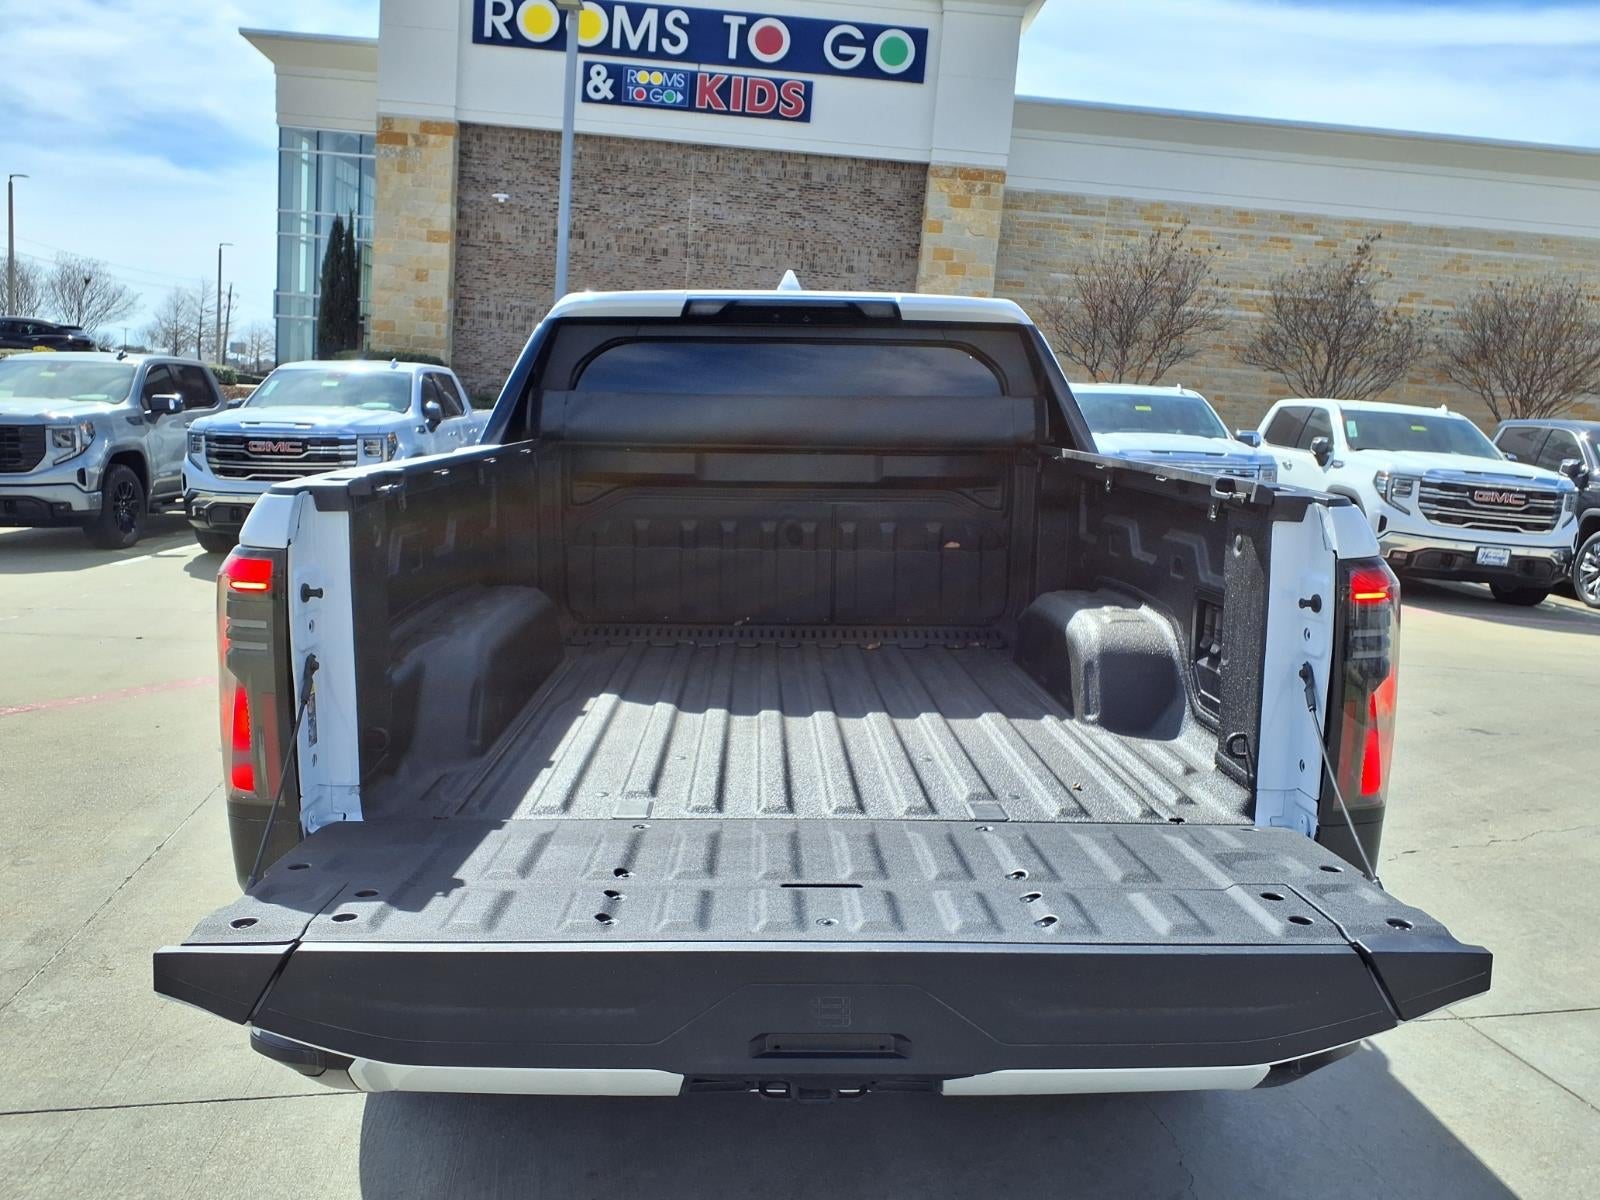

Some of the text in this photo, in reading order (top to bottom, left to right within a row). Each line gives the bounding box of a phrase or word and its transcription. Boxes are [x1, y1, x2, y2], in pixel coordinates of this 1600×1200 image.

[483, 0, 916, 74] ROOMS TO GO
[586, 64, 615, 100] &
[627, 69, 685, 88] ROOMS
[627, 86, 678, 103] TO GO
[695, 72, 806, 118] KIDS
[249, 441, 303, 452] GMC
[1474, 490, 1526, 505] GMC
